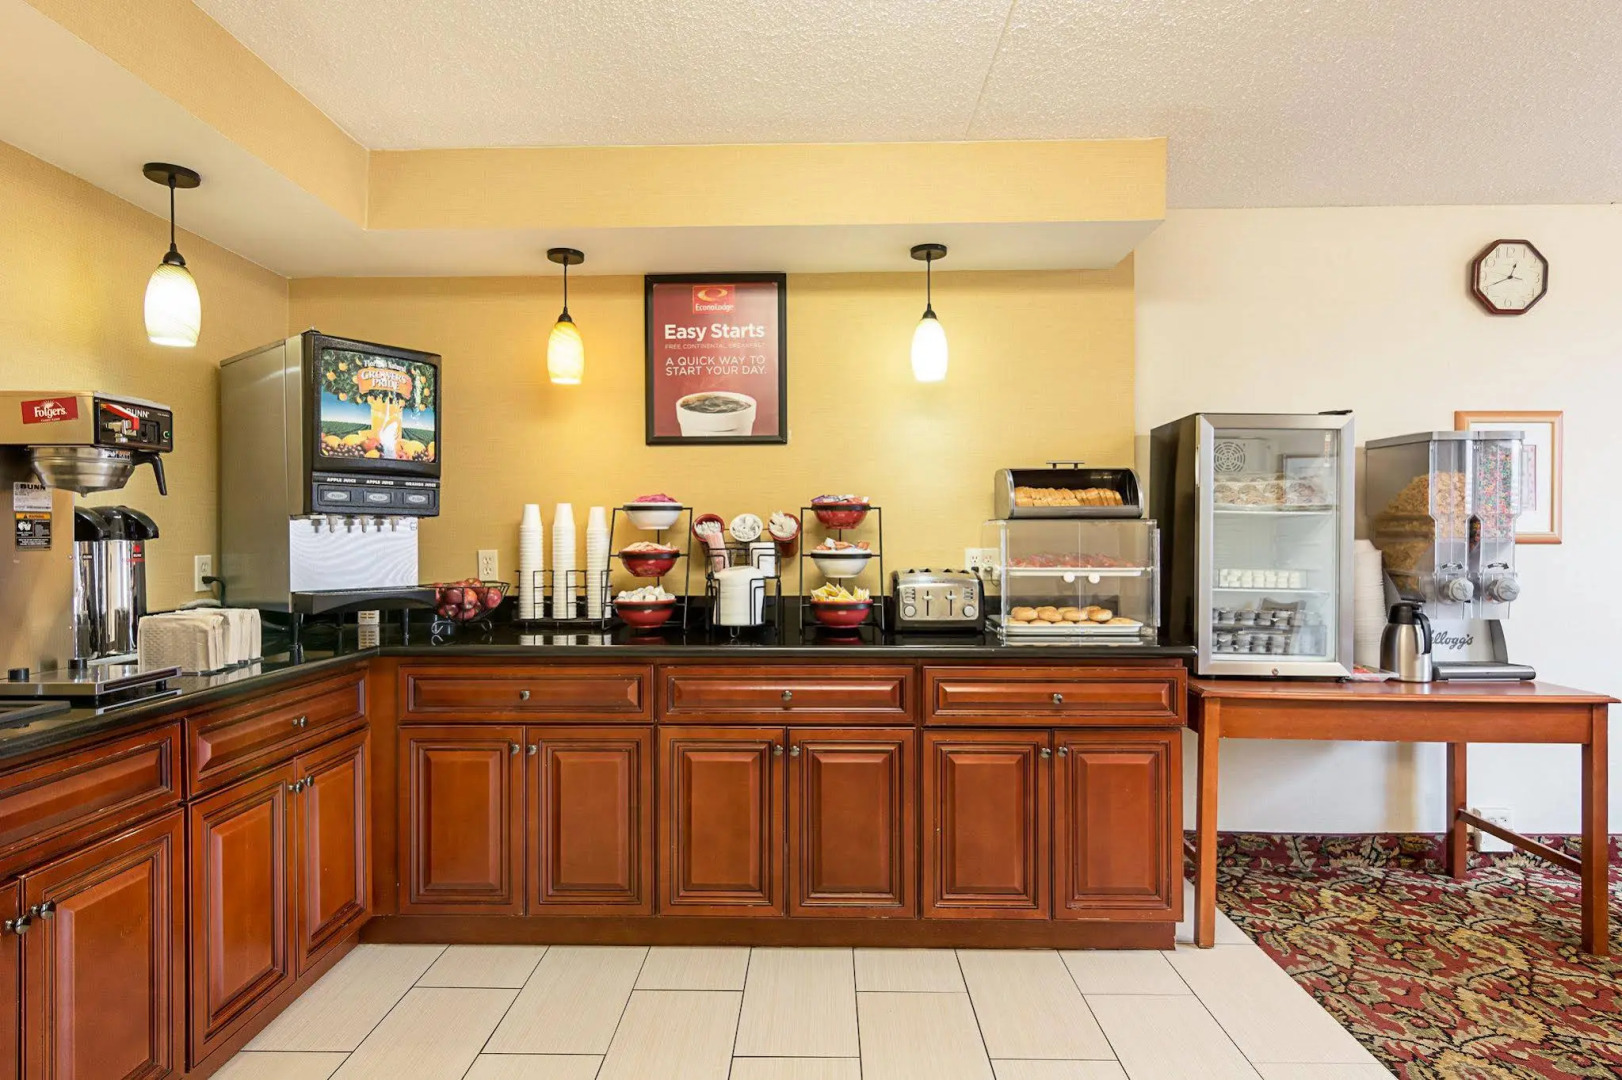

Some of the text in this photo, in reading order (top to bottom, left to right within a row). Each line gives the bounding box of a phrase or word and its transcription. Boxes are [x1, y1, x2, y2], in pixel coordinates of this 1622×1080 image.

[1506, 247, 1515, 258] 12
[664, 323, 765, 341] Easy Starts
[666, 355, 766, 366] A QUICK WAY TO
[666, 365, 767, 376] START YOUR DAY.
[34, 405, 67, 418] Folgers
